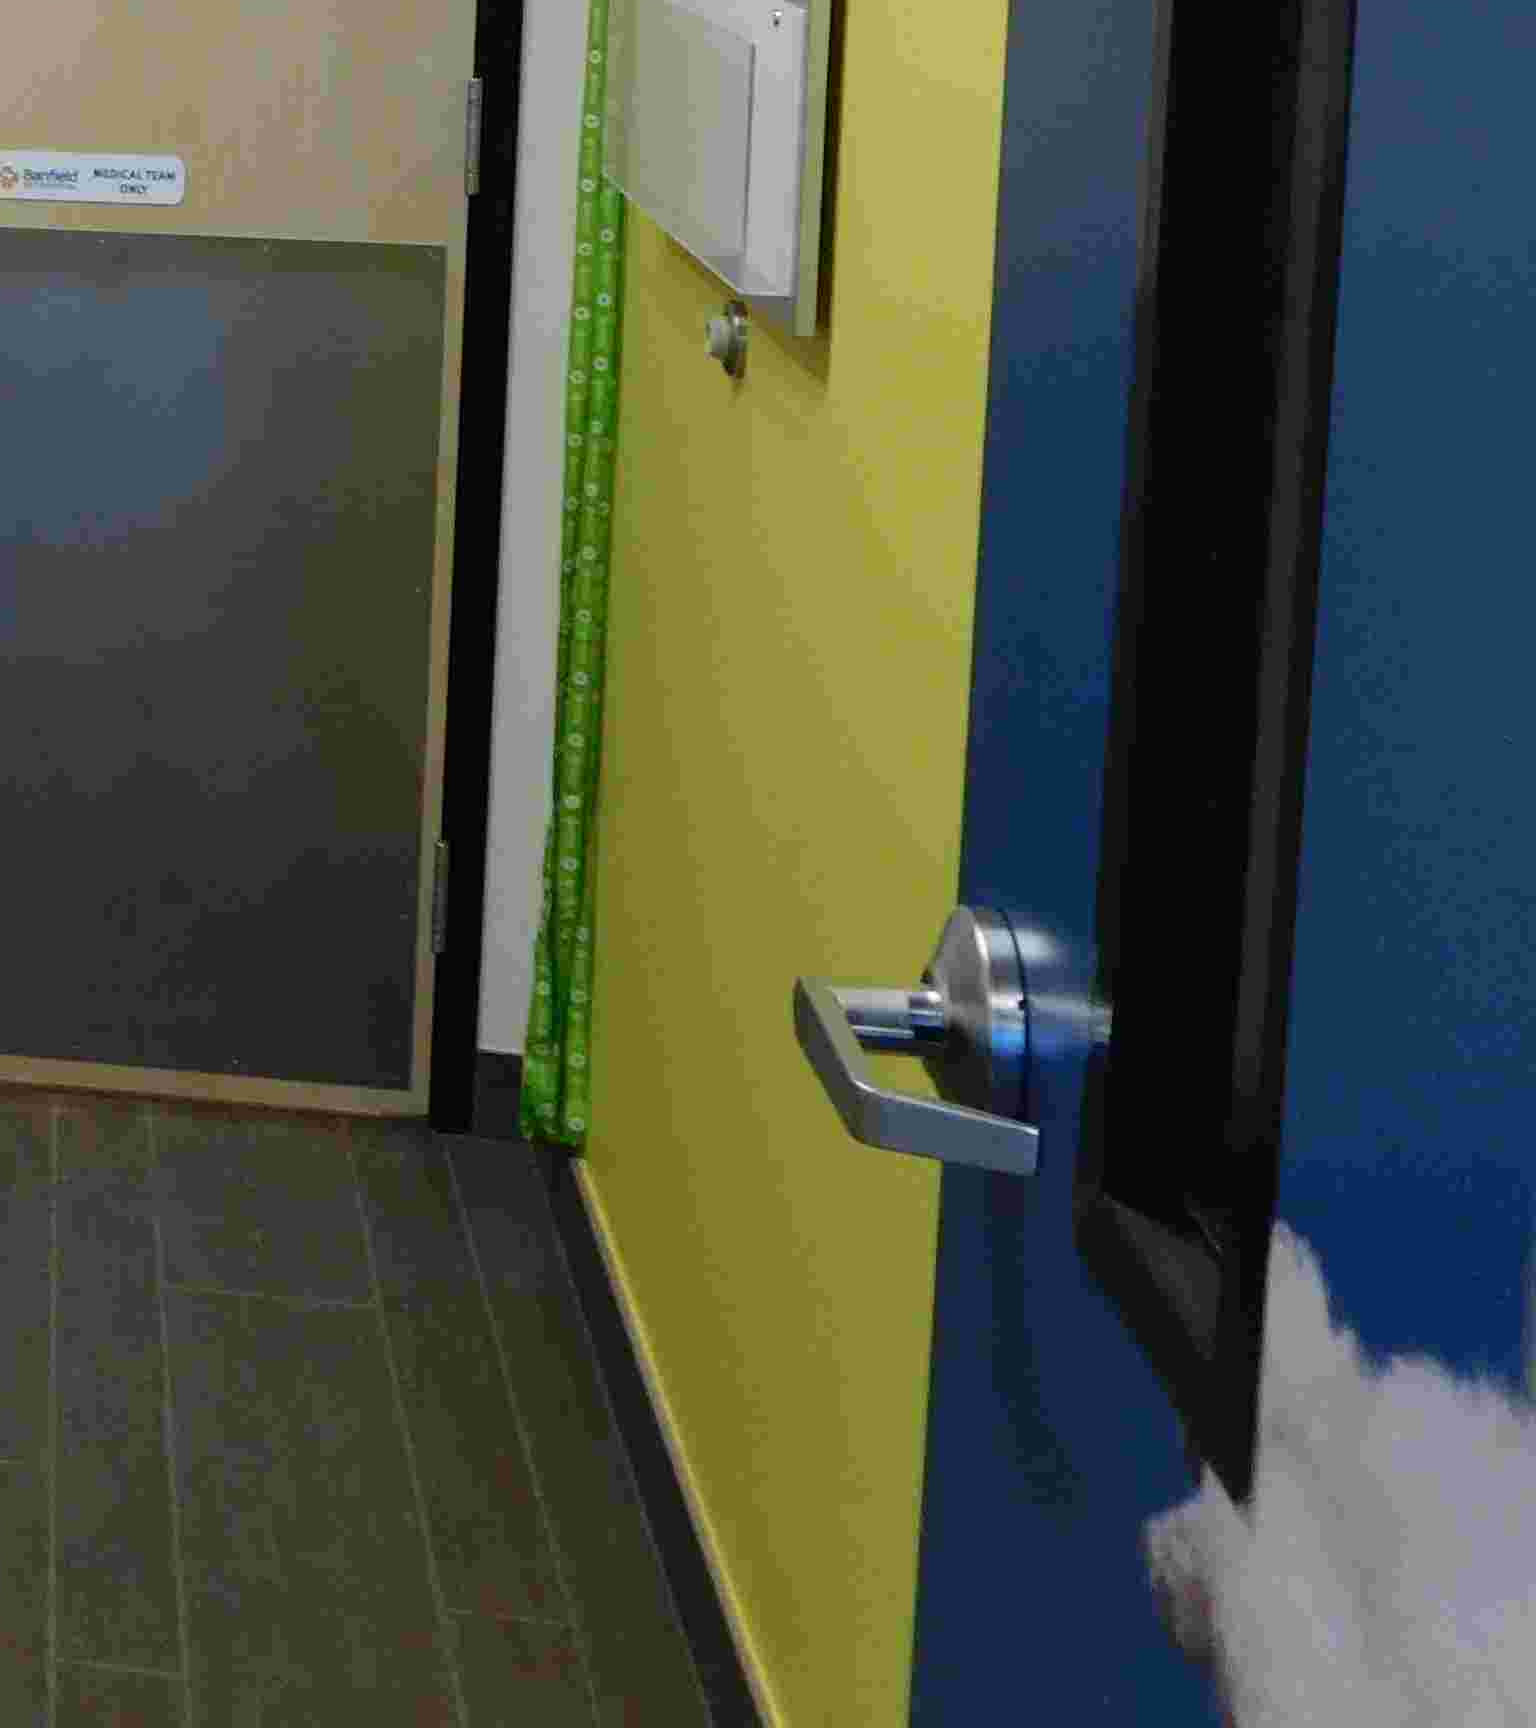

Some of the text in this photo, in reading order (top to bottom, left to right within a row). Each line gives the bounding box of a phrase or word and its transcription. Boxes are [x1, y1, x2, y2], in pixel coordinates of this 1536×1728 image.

[94, 167, 176, 182] MEDICAL TEAM
[120, 183, 149, 195] ONLY
